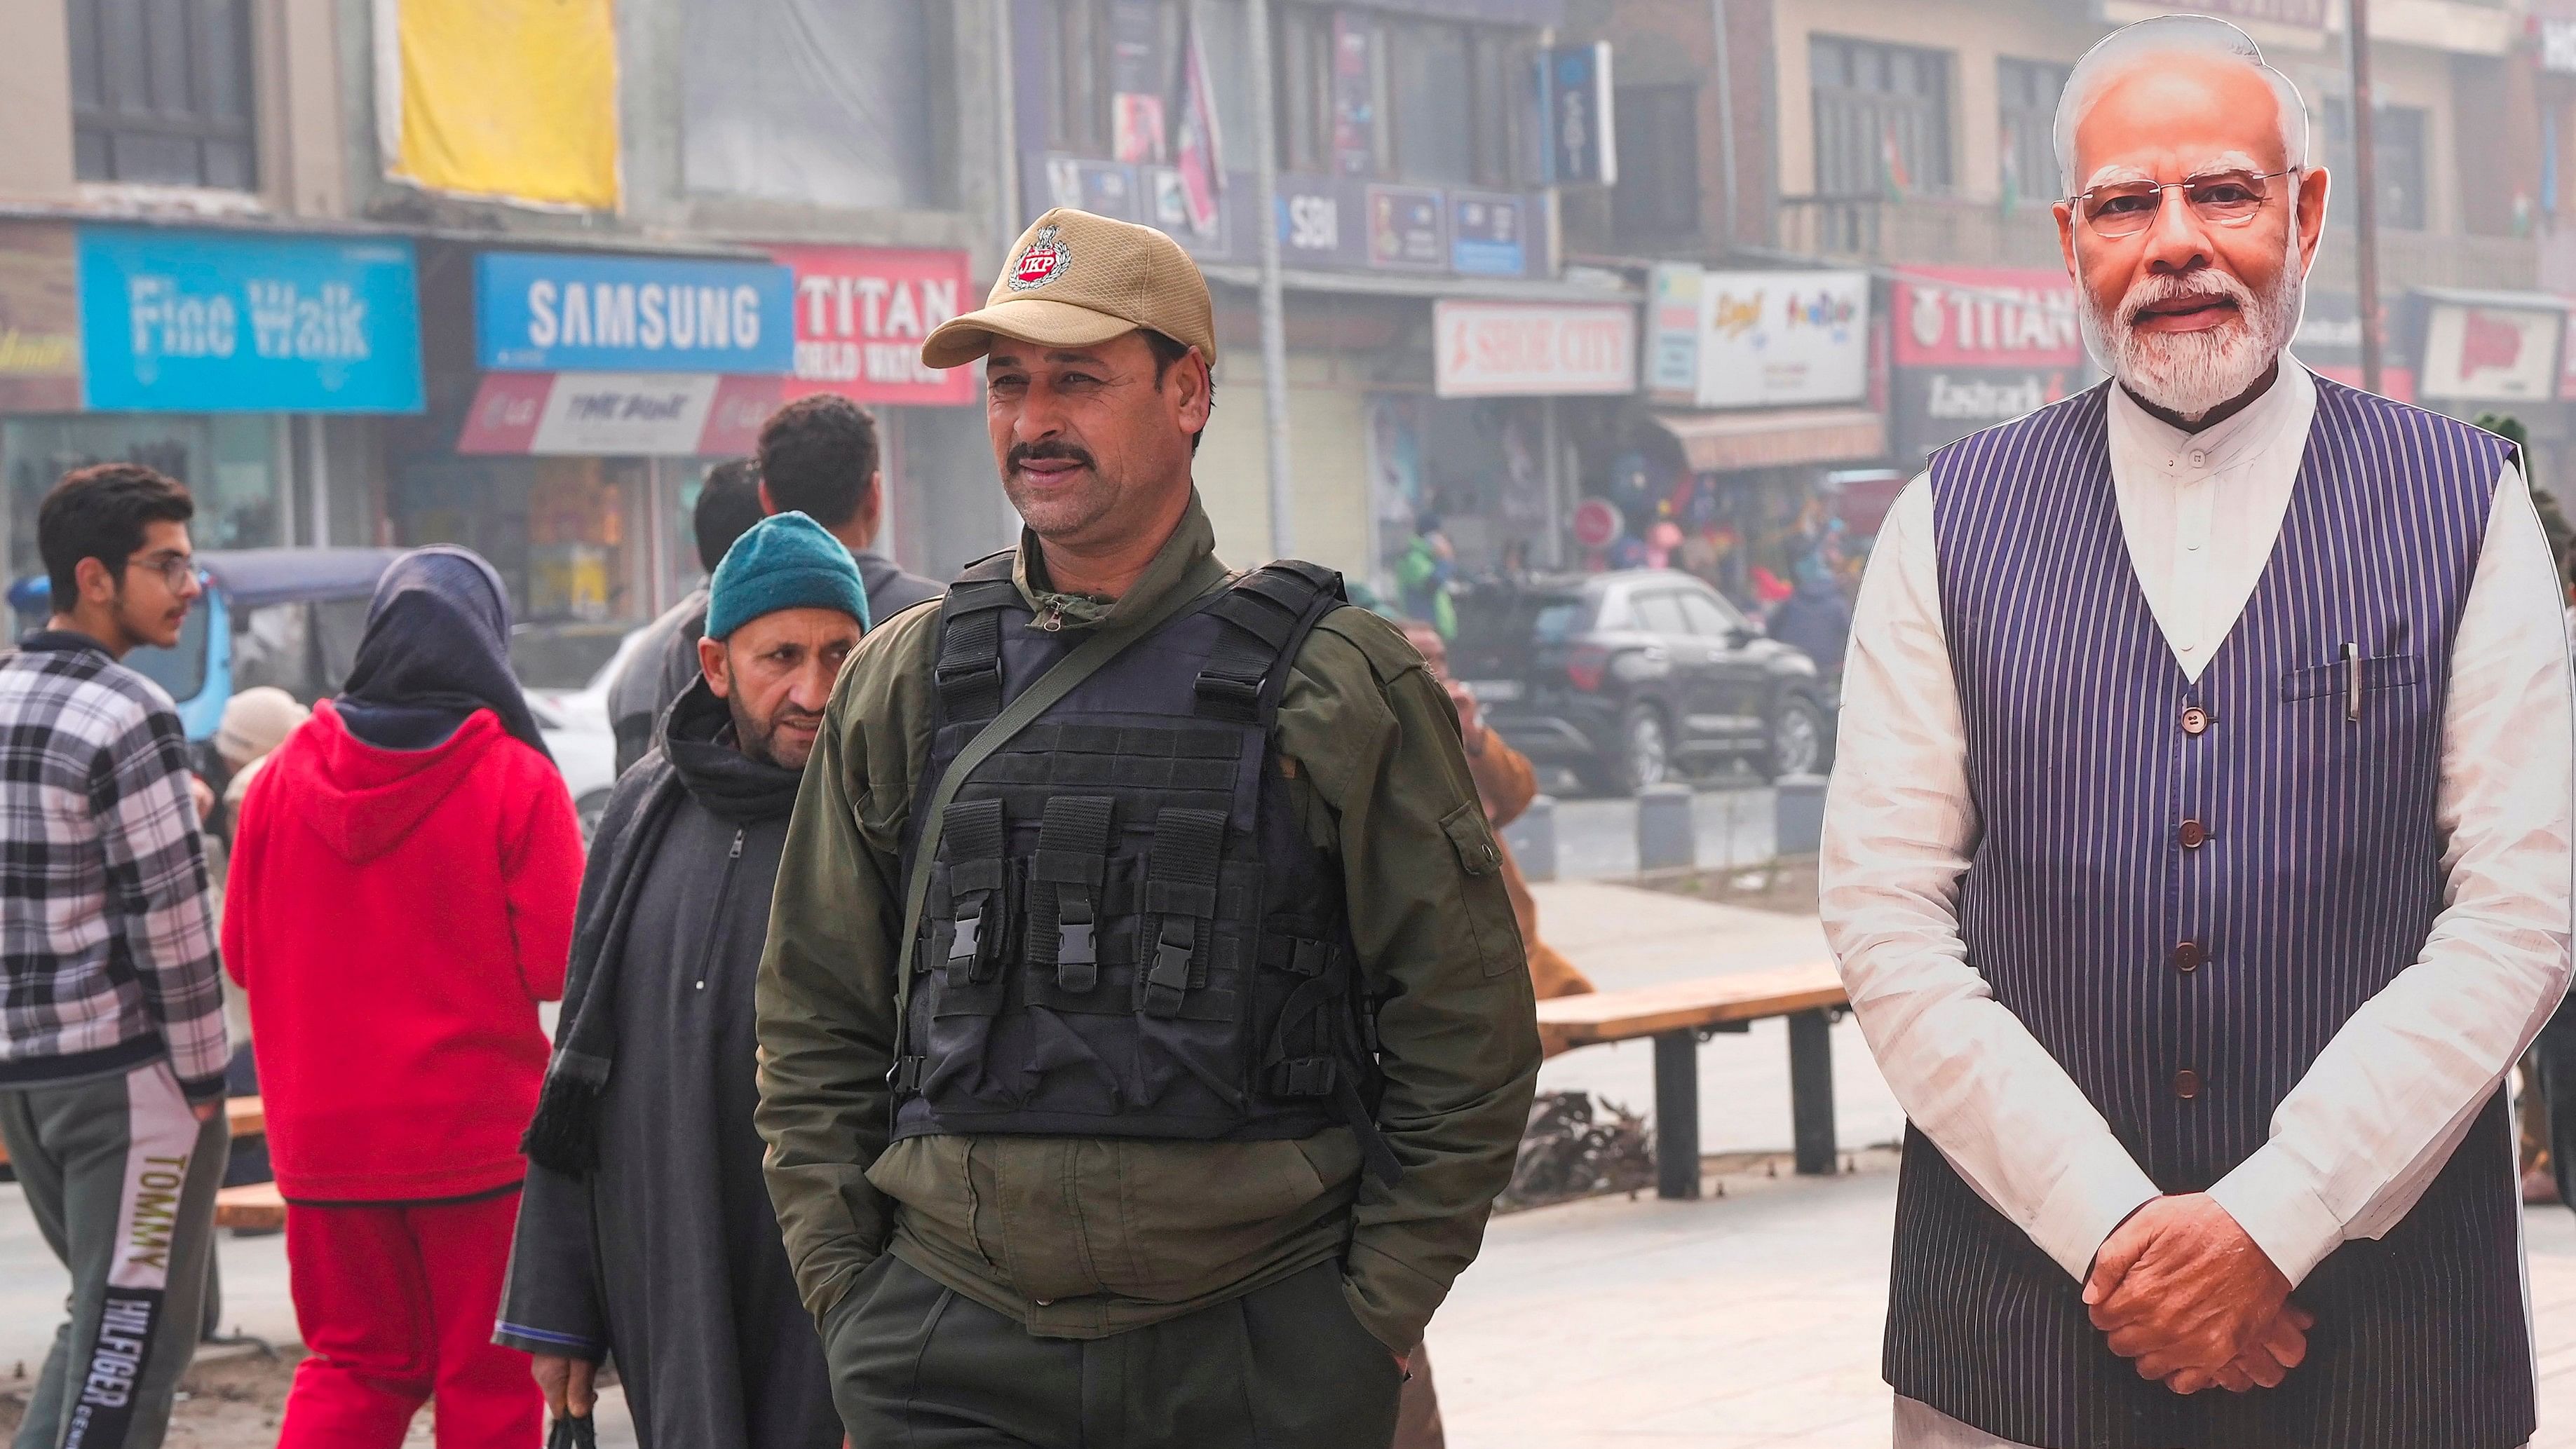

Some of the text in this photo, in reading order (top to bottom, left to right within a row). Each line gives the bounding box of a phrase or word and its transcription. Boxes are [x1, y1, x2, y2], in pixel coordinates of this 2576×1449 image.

[1019, 257, 1055, 275] JKP
[246, 278, 372, 360] Walk
[528, 279, 761, 349] SAMSUNG
[797, 275, 959, 338] TITAN
[1948, 285, 2077, 349] TITAN
[1559, 319, 1623, 373] CITY
[128, 1155, 187, 1270] TOMMY
[81, 1298, 152, 1408] HILFIGER
